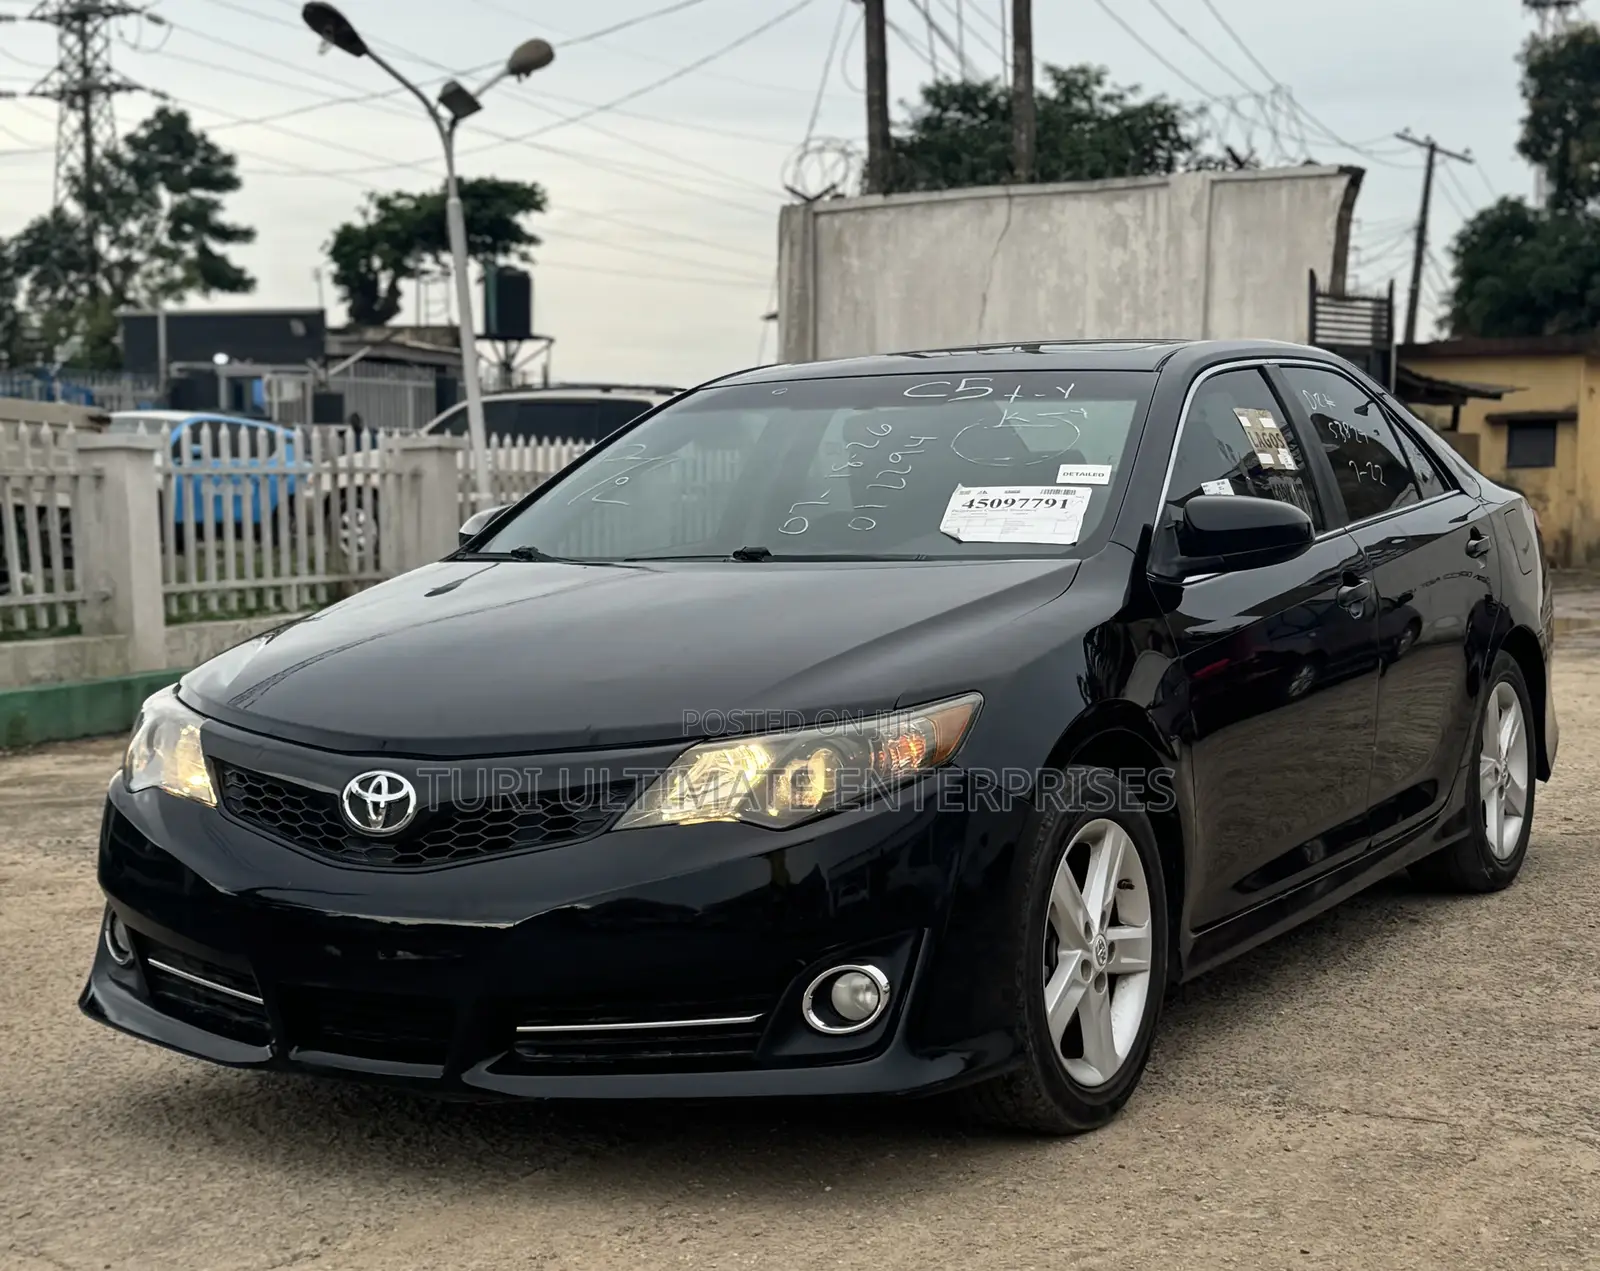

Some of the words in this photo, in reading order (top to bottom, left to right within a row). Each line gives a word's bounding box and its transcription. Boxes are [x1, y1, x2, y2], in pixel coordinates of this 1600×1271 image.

[903, 378, 994, 402] C5
[1247, 431, 1286, 449] LAGOS
[961, 497, 1070, 510] 45097791
